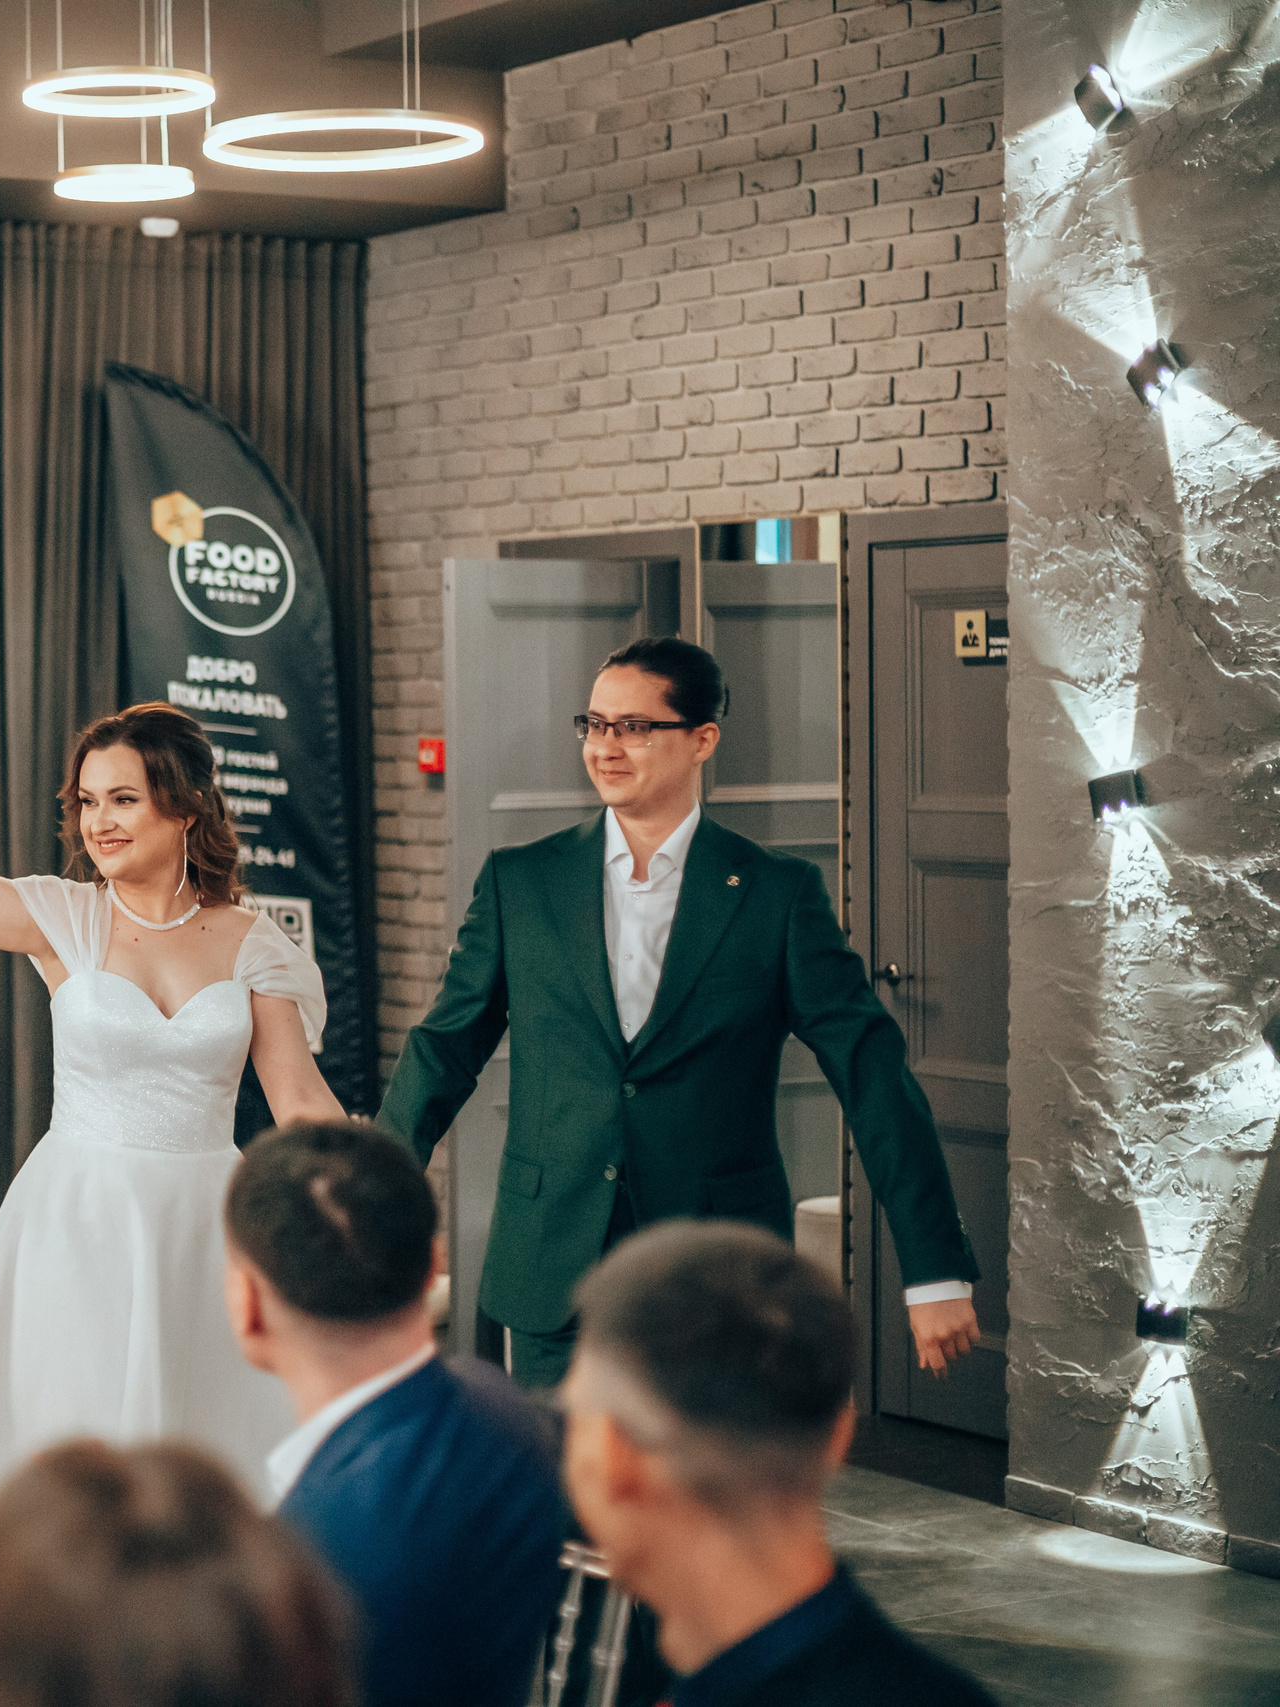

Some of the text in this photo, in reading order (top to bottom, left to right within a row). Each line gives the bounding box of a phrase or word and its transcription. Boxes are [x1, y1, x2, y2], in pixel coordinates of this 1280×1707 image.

[184, 541, 281, 575] FOOD
[185, 566, 280, 593] FACTORY
[186, 655, 257, 686] ДОБРО
